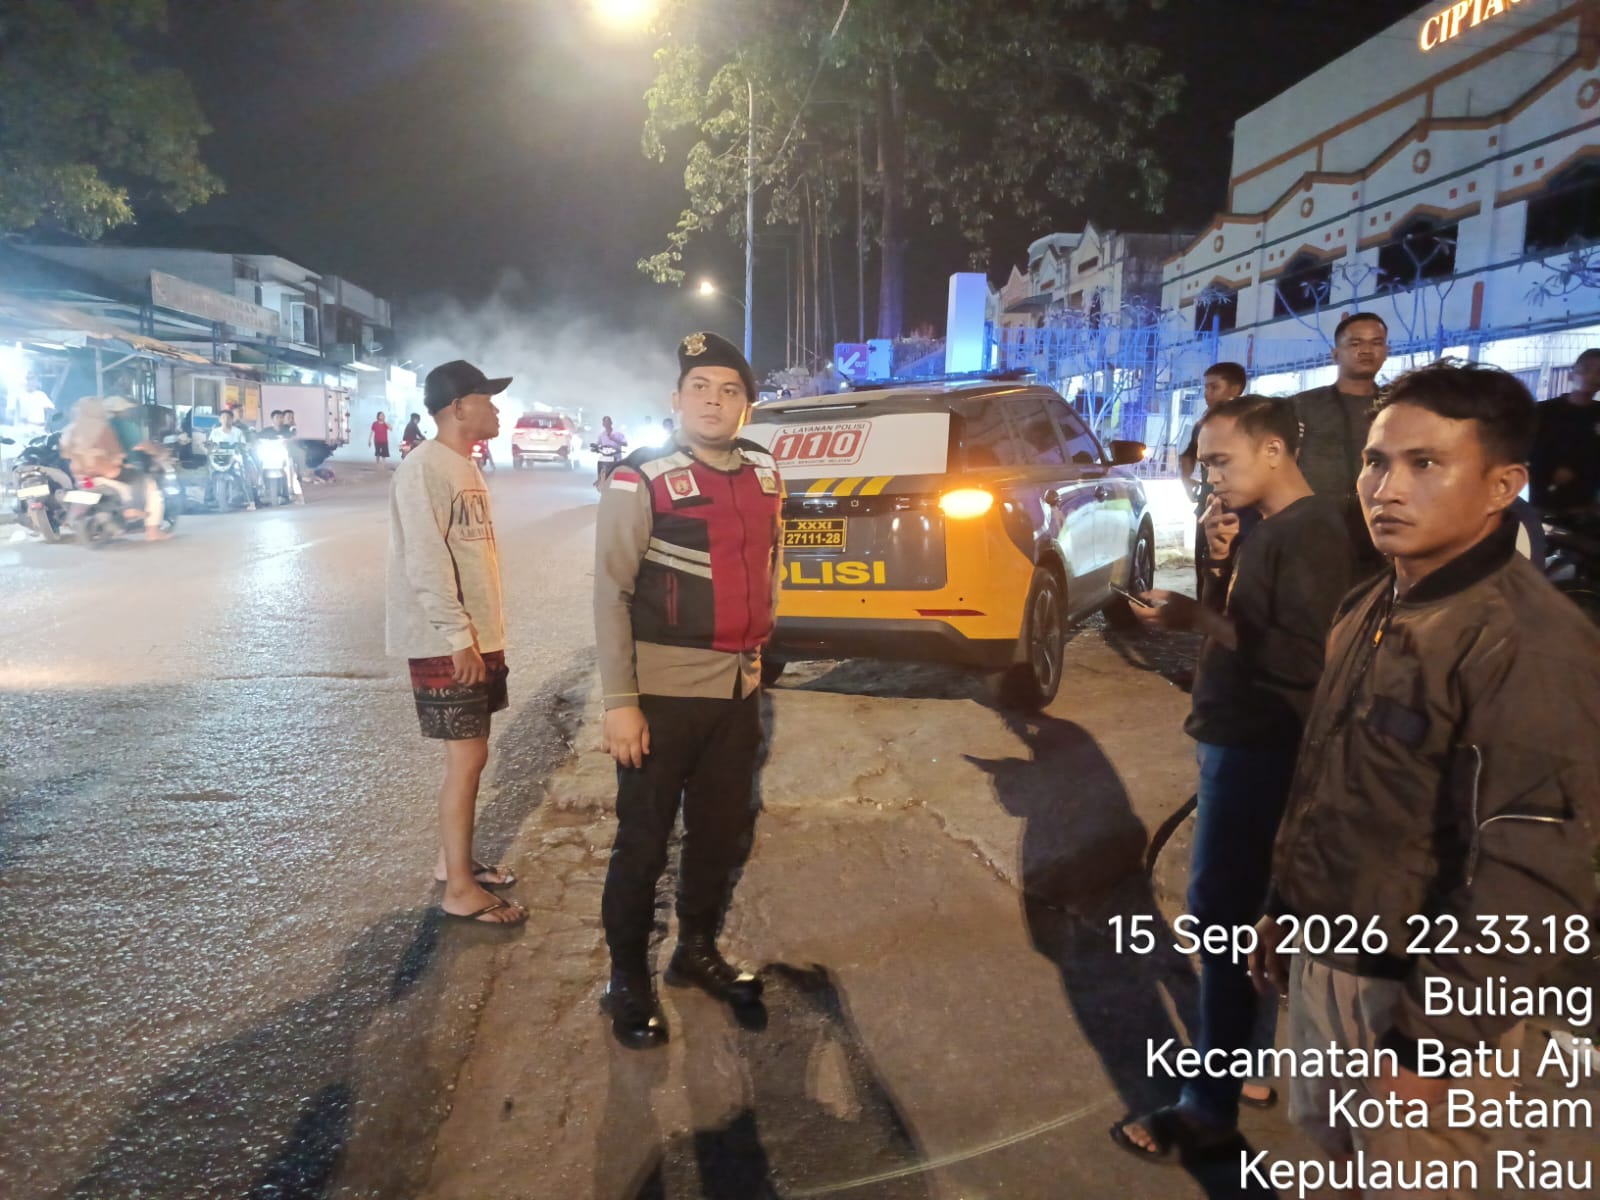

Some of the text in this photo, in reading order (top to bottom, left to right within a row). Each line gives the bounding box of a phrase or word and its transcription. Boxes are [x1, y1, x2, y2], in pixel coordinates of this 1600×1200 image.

[1420, 0, 1504, 51] CIPTA
[792, 423, 866, 434] LAYANAN POLISI
[778, 432, 857, 459] 110
[797, 521, 832, 530] XXXI
[786, 532, 841, 545] 27111-28
[782, 561, 886, 584] LISI
